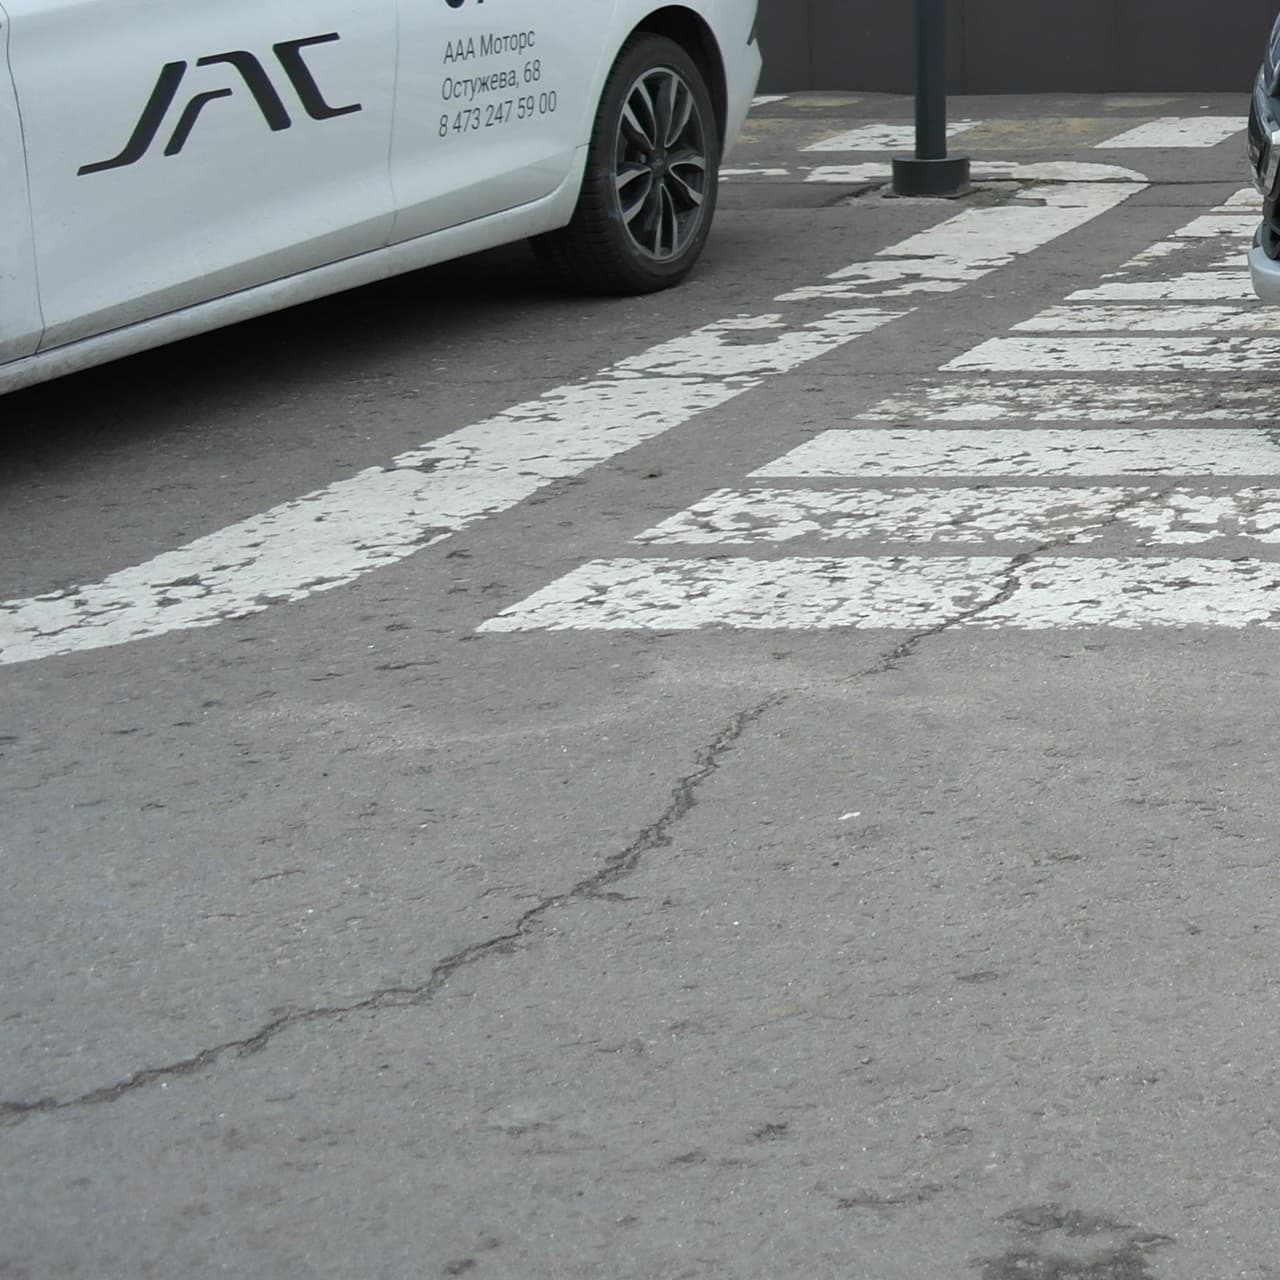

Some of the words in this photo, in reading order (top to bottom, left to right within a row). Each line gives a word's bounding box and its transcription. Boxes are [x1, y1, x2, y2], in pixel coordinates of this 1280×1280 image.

[479, 29, 537, 57] Моторс
[441, 69, 520, 102] Остужева,
[523, 59, 542, 84] 68
[76, 31, 363, 177] JAC
[438, 114, 449, 138] 8
[452, 107, 482, 134] 473
[485, 100, 514, 128] 247
[517, 94, 536, 120] 59
[538, 89, 558, 115] 00
